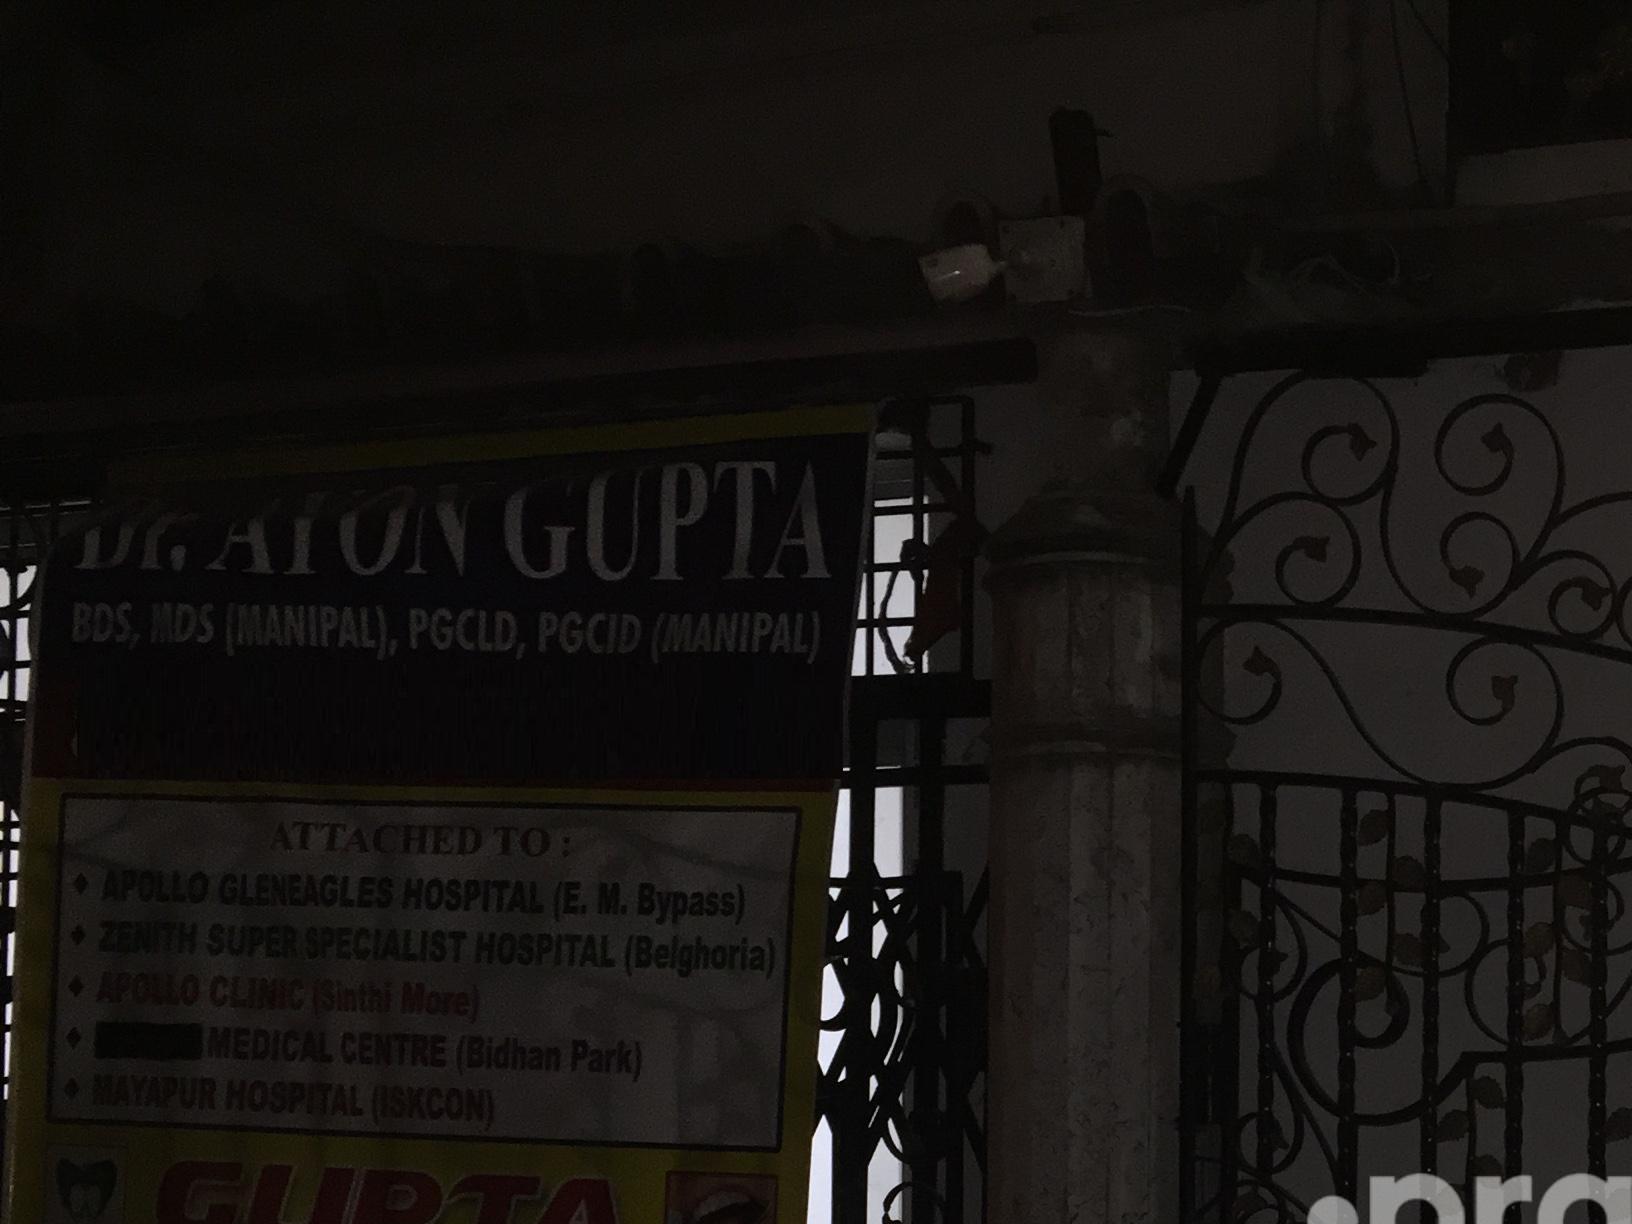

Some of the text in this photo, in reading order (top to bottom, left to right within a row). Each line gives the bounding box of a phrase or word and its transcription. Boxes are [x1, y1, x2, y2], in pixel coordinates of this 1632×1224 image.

[504, 460, 832, 582] GUPTA
[72, 601, 140, 651] BDS,
[150, 603, 214, 645] MDS
[537, 610, 642, 655] PGCID
[650, 610, 822, 665] (MANIPAL)
[270, 821, 481, 856] ATTACHED
[495, 826, 550, 857] TO
[102, 869, 209, 904] APOLLO
[218, 872, 394, 908] GLENEAGLES
[401, 878, 545, 914] HOSPITAL
[597, 882, 627, 914] M.
[638, 883, 746, 925] Bypass)
[99, 920, 775, 978] ZENITH SUPER SPECIALIST HOSPITAL (Belghoria)
[96, 971, 199, 1007] APOLLO
[210, 975, 304, 1010] CLINIC
[401, 982, 480, 1024] More)
[208, 1027, 643, 1083] MEDICAL CENTRE (Bidhan Park)
[93, 1074, 495, 1131] MAYAPUR HOSPITAL (ISKCON)
